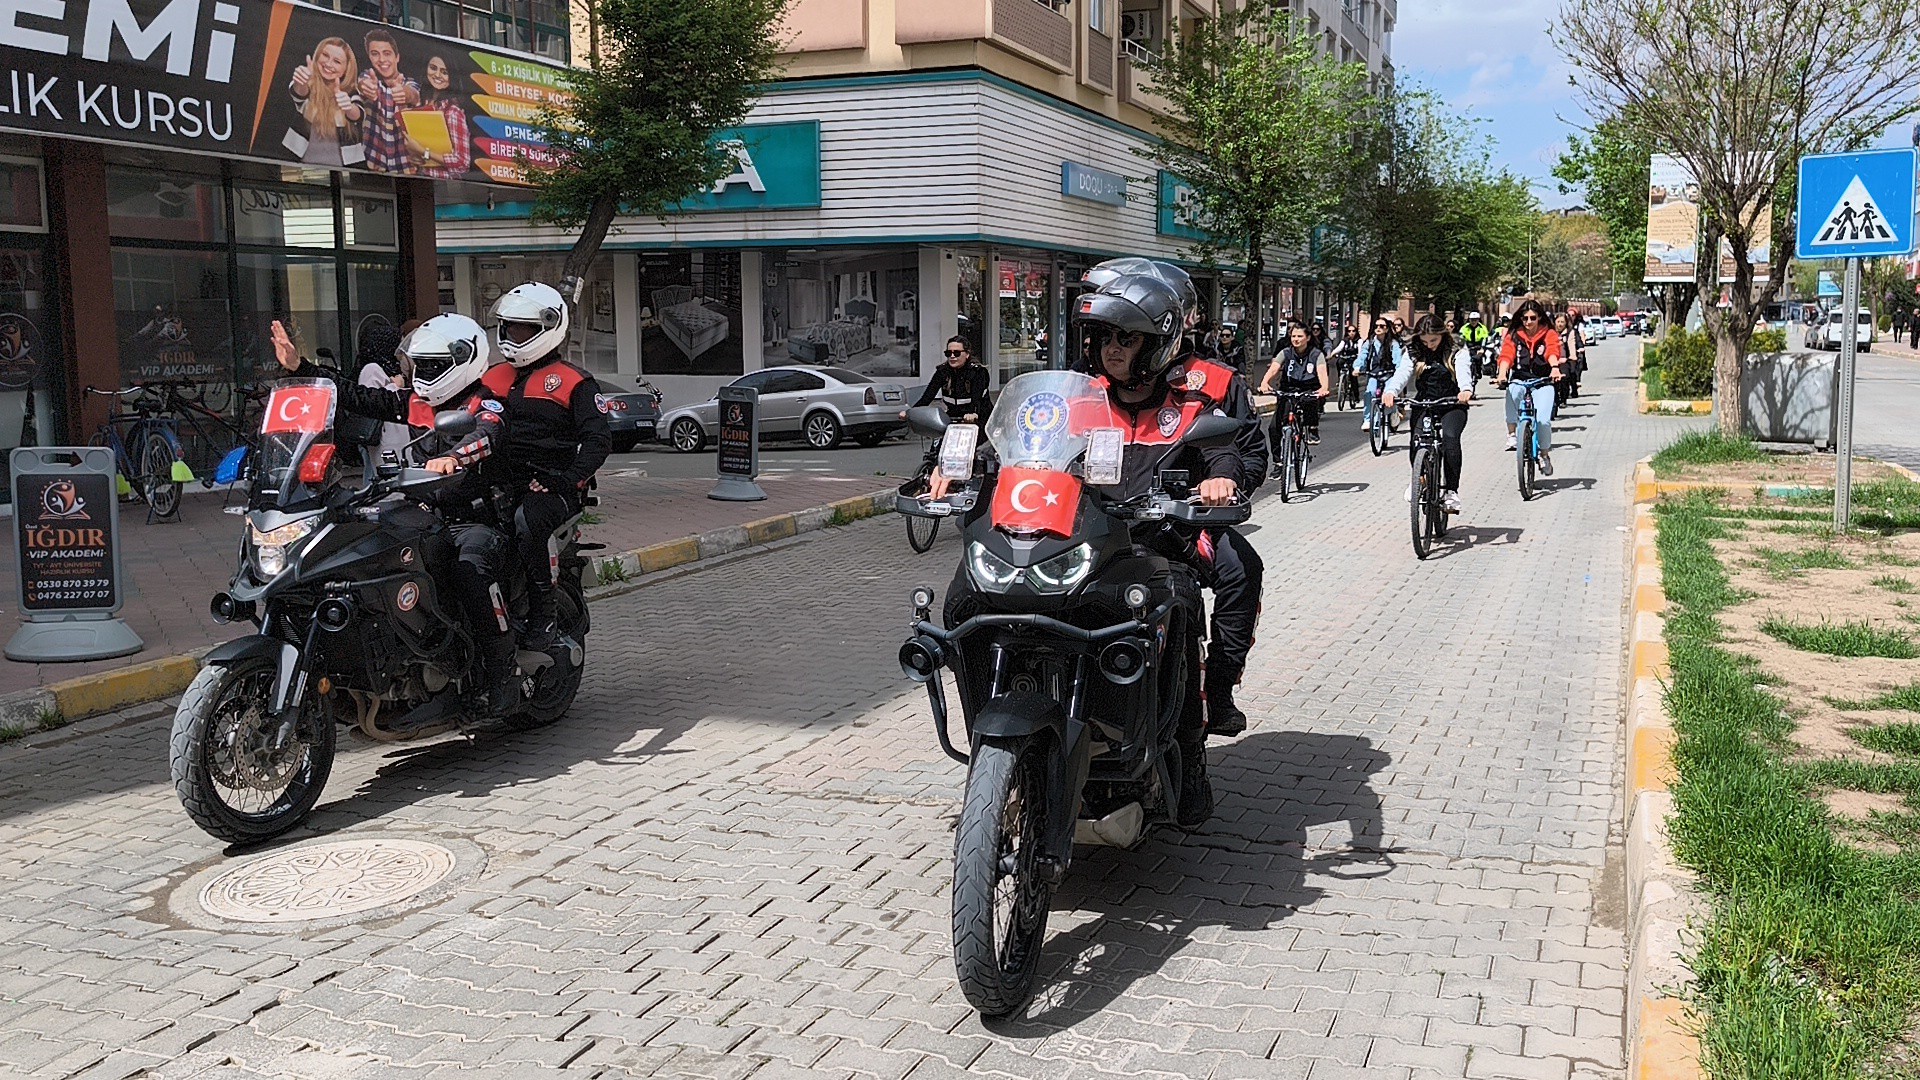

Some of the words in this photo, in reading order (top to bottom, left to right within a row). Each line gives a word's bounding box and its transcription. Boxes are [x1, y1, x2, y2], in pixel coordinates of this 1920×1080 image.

[491, 61, 497, 73] 6
[502, 64, 512, 76] 12
[513, 65, 541, 83] KİŞİLİK
[78, 80, 232, 141] KURSU
[488, 101, 515, 117] UZMAN
[26, 524, 106, 548] IĞDIR
[37, 580, 61, 589] 0530
[62, 580, 81, 588] 870
[82, 579, 96, 588] 39
[96, 579, 109, 587] 79
[37, 591, 62, 600] 0476
[63, 590, 81, 599] 227
[83, 590, 96, 599] 07
[97, 590, 110, 598] 07
